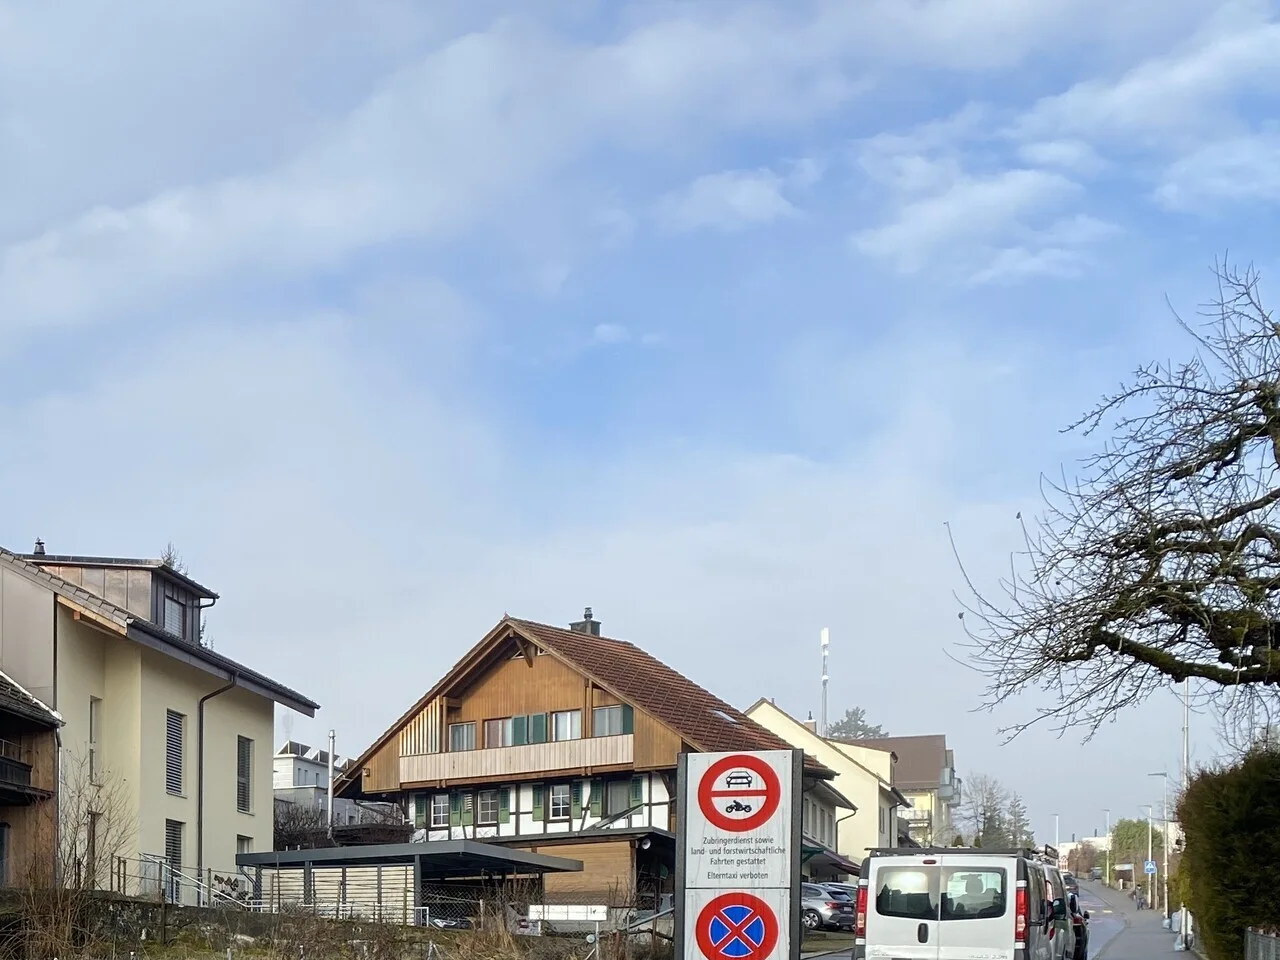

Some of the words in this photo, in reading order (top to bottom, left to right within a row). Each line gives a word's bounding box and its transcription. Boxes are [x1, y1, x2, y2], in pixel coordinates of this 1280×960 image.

[702, 837, 753, 846] Zubringerdienst
[691, 847, 707, 855] land-
[709, 847, 721, 855] und
[722, 847, 786, 855] forstwirtschaftliche
[710, 858, 735, 866] Fahrten
[736, 858, 766, 867] gestattet
[707, 871, 738, 879] Elterntaxi
[739, 871, 769, 879] verboten
